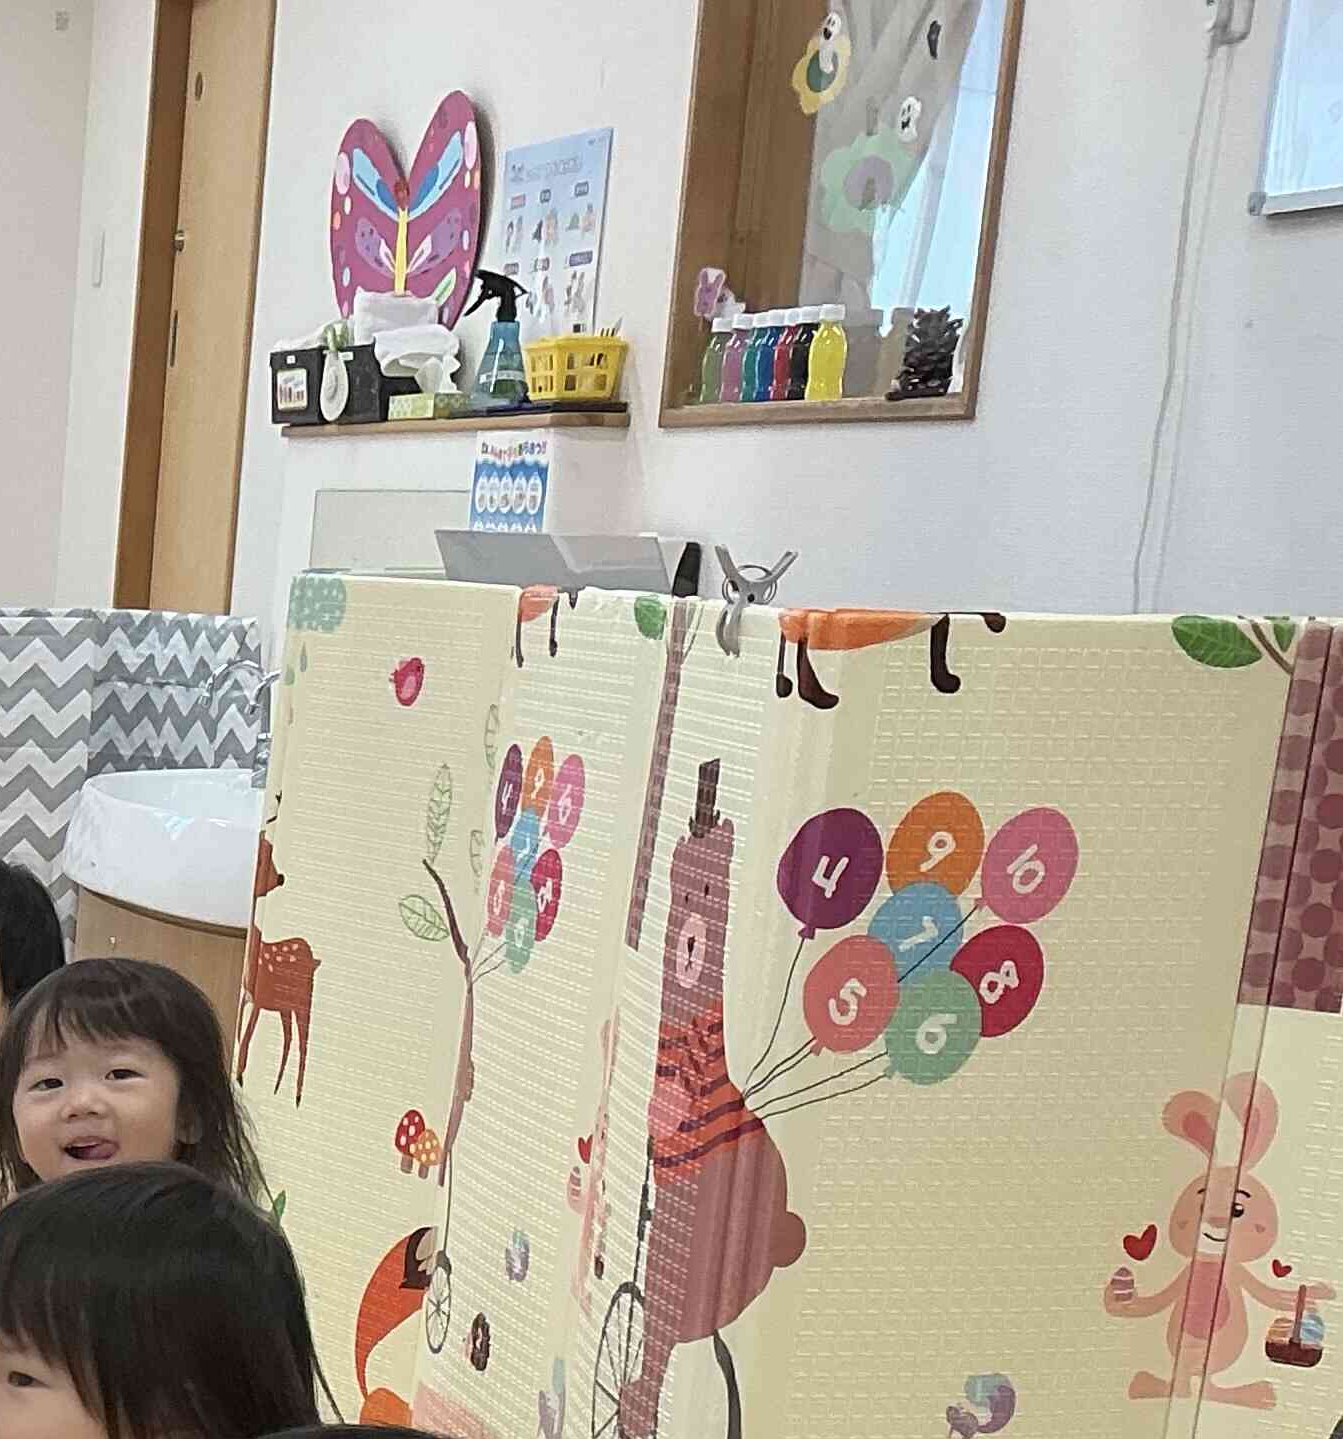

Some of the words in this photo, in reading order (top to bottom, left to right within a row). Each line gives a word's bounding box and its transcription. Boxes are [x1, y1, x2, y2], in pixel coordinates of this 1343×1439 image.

[919, 831, 956, 873] 9
[1006, 844, 1046, 894] 10
[811, 855, 849, 898] 4
[898, 916, 940, 952] 7
[828, 977, 867, 1026] 5
[978, 960, 1020, 1005] 8
[915, 1013, 959, 1055] 6
